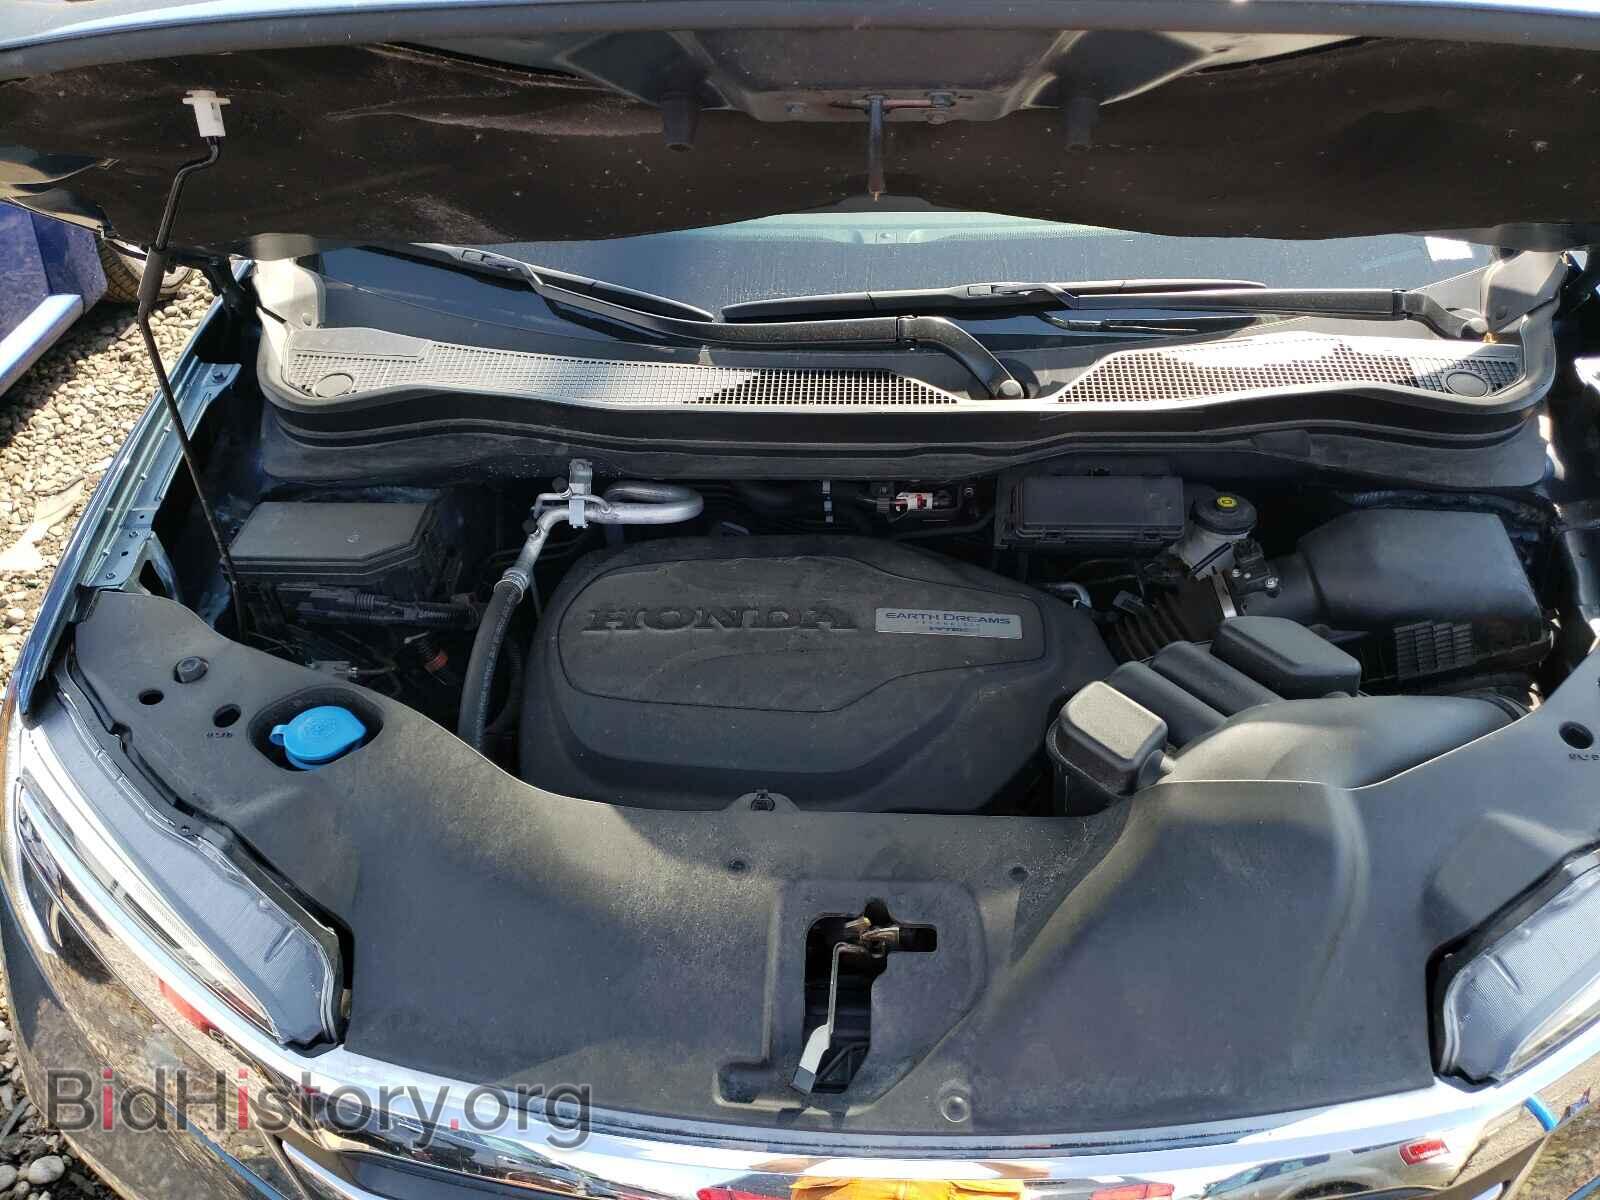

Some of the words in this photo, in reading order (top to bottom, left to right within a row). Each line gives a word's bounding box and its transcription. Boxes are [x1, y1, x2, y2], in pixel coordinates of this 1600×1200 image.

[580, 607, 858, 633] HONDA
[885, 611, 939, 622] EARTH
[943, 612, 1012, 625] DREAMS
